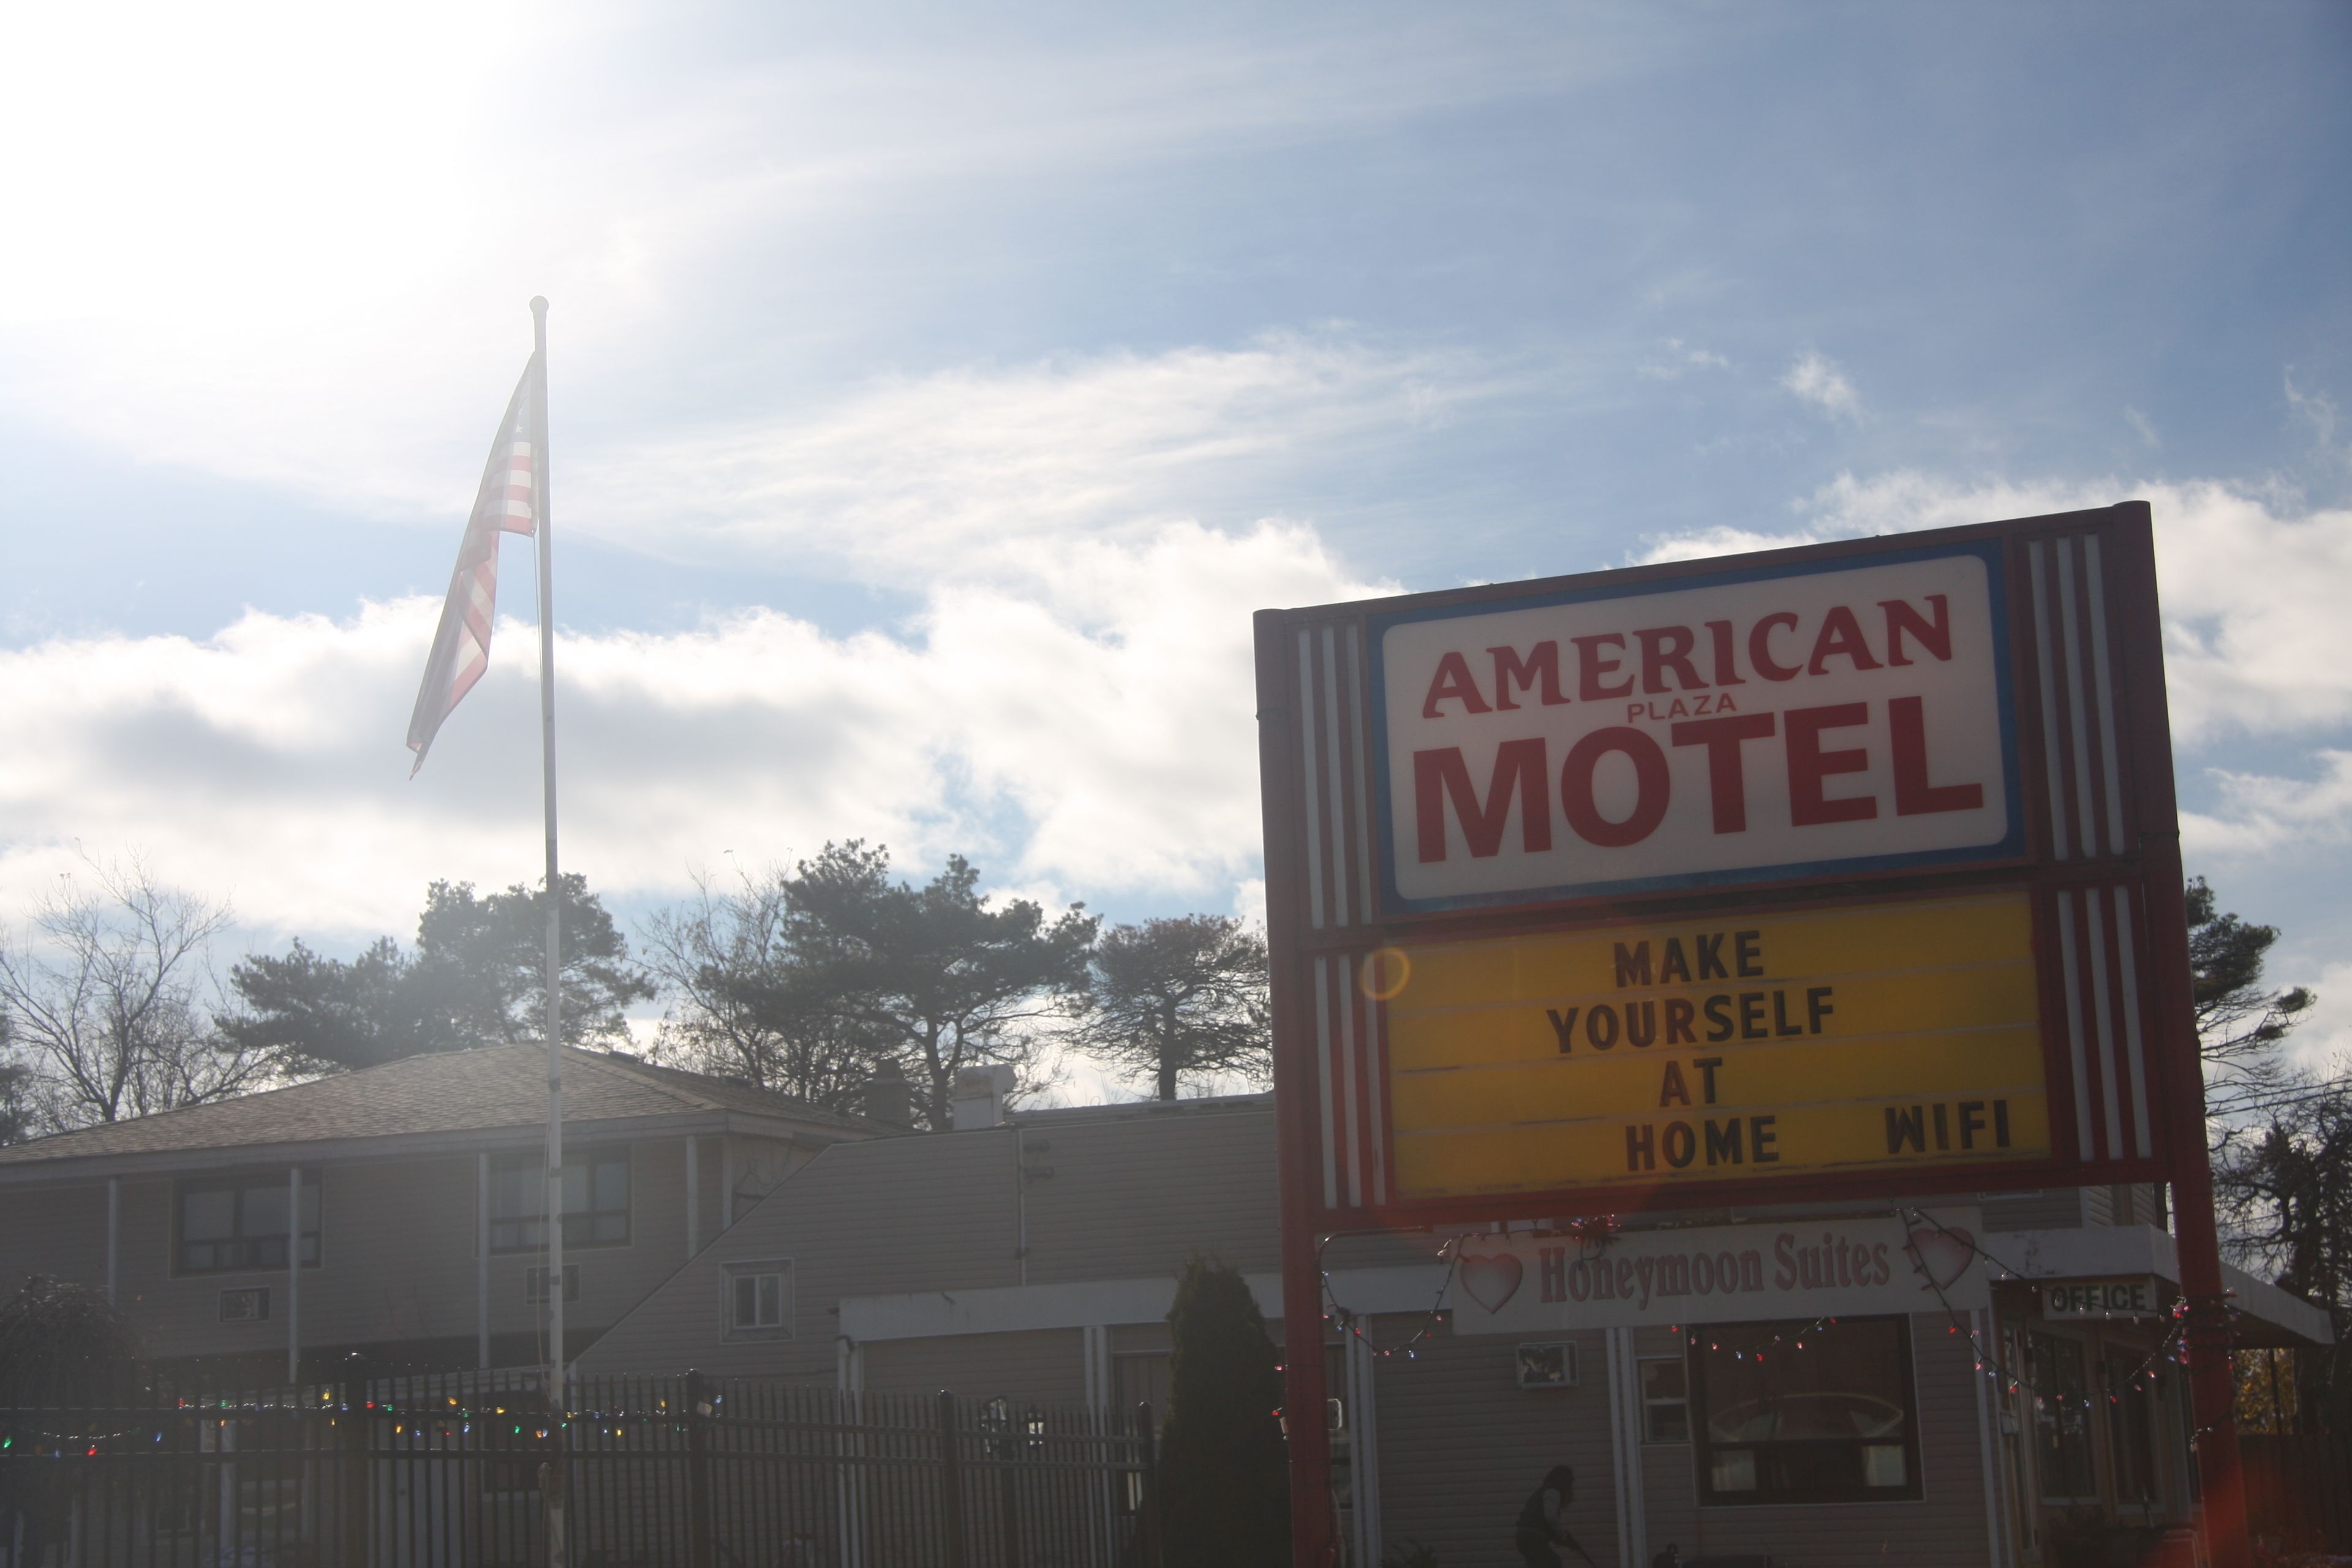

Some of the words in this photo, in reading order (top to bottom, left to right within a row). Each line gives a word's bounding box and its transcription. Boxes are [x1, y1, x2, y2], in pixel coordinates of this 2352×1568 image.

[1422, 594, 1953, 718] AMERICAN
[1627, 692, 1737, 723] PLAZA
[1412, 695, 1984, 864] MOTEL
[1613, 930, 1765, 989] MAKE
[1546, 987, 1834, 1054] YOURSELF
[1659, 1057, 1723, 1108] AT
[1625, 1115, 1779, 1172] HOME
[1885, 1099, 2011, 1155] WIFI
[1539, 1245, 1764, 1311] Honeymoon
[1774, 1232, 1890, 1291] Suites
[2050, 1285, 2147, 1313] OFFICE
